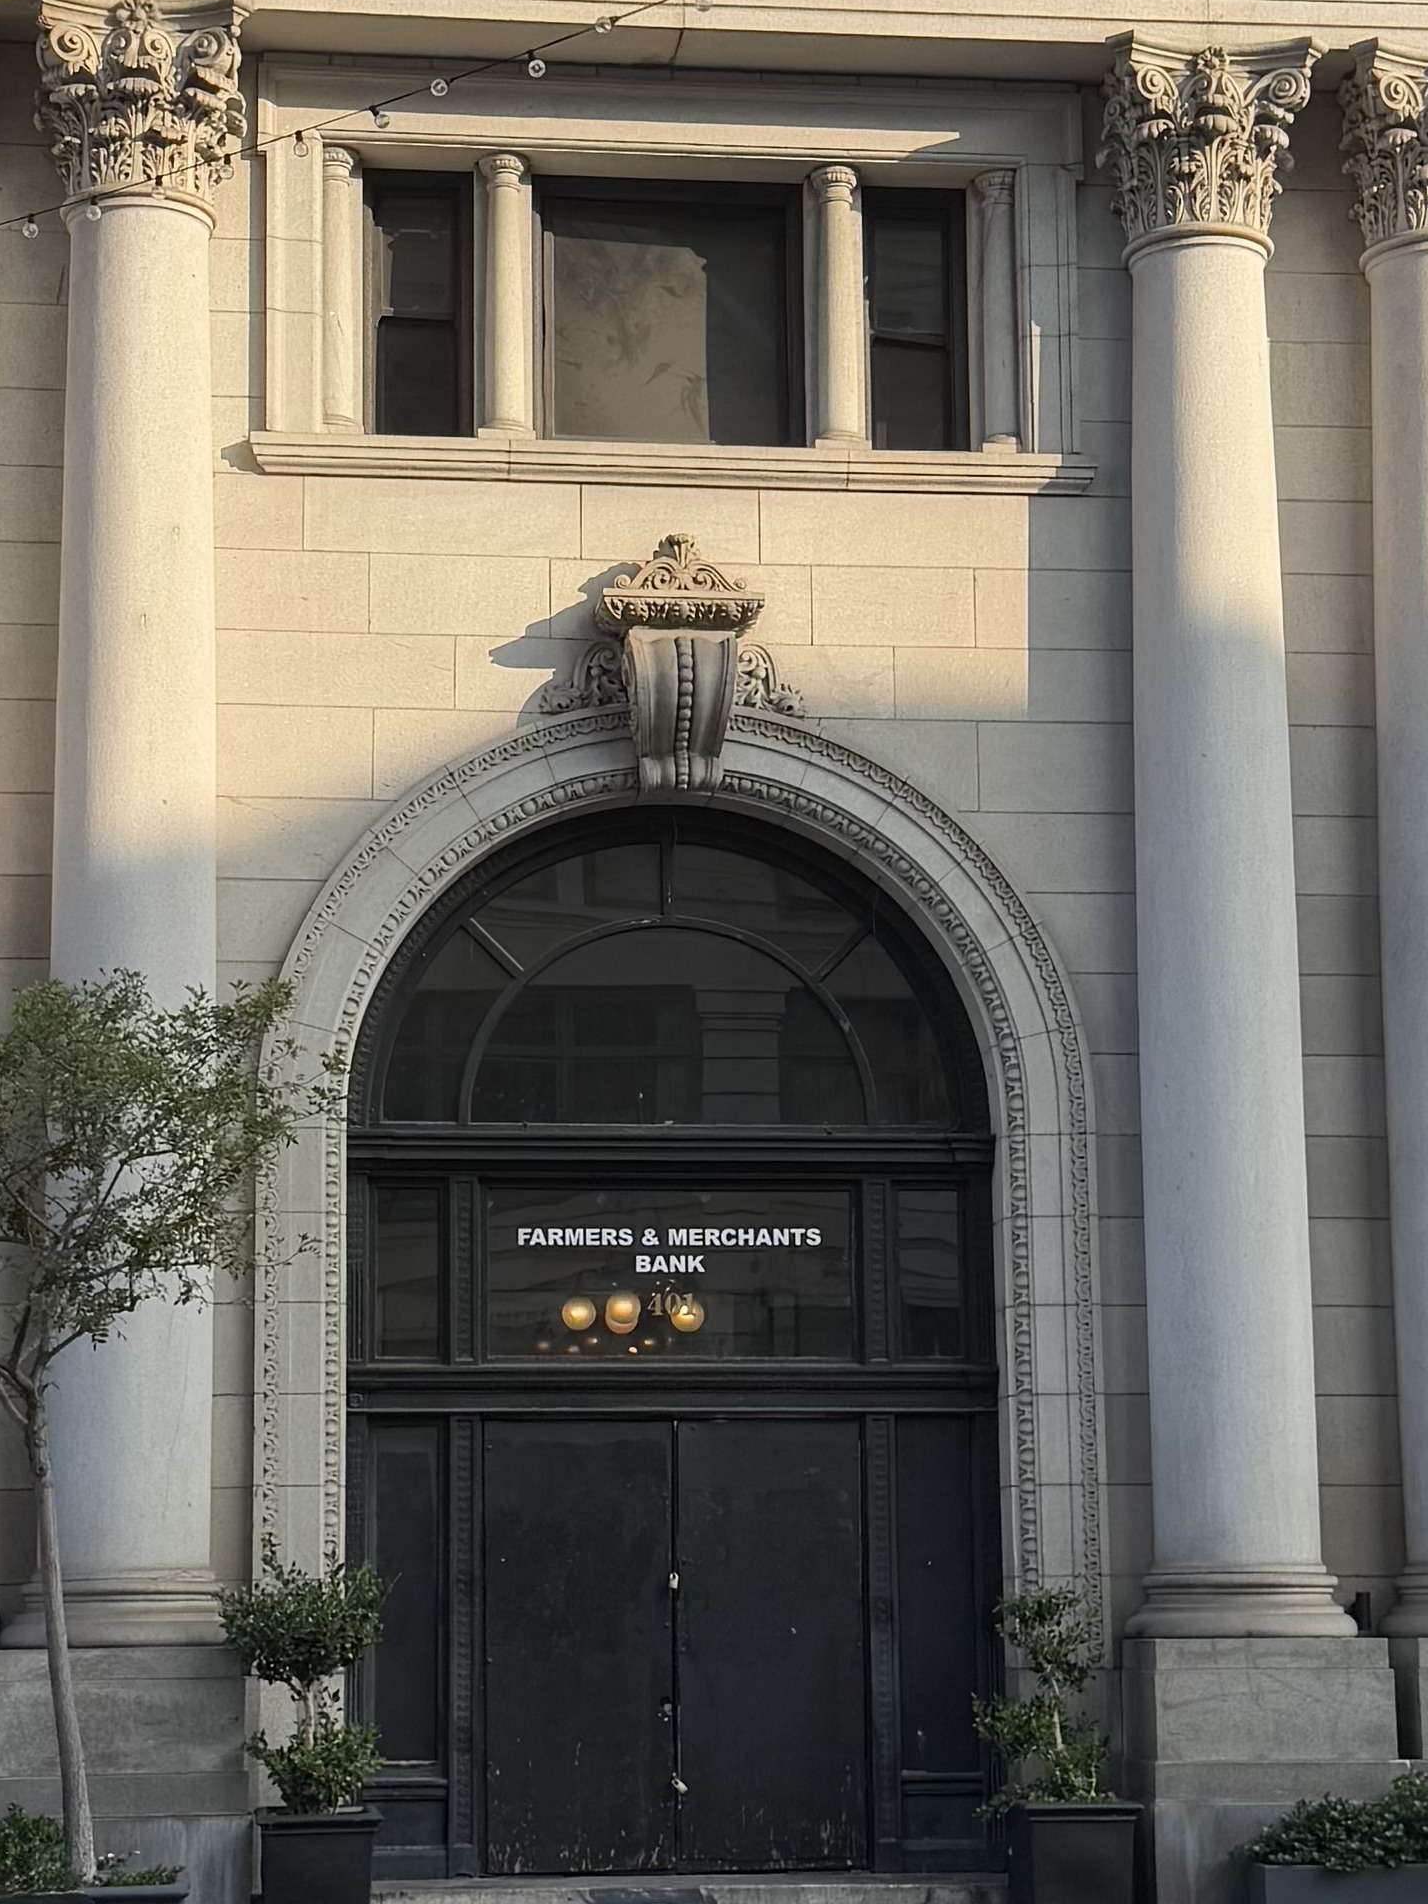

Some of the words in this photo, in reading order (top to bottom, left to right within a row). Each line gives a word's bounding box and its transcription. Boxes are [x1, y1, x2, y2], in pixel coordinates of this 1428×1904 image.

[517, 1227, 634, 1246] FARMERS
[641, 1227, 660, 1246] &
[667, 1227, 823, 1247] MERCHANTS
[634, 1254, 706, 1274] BANK
[646, 1292, 697, 1317] 401
